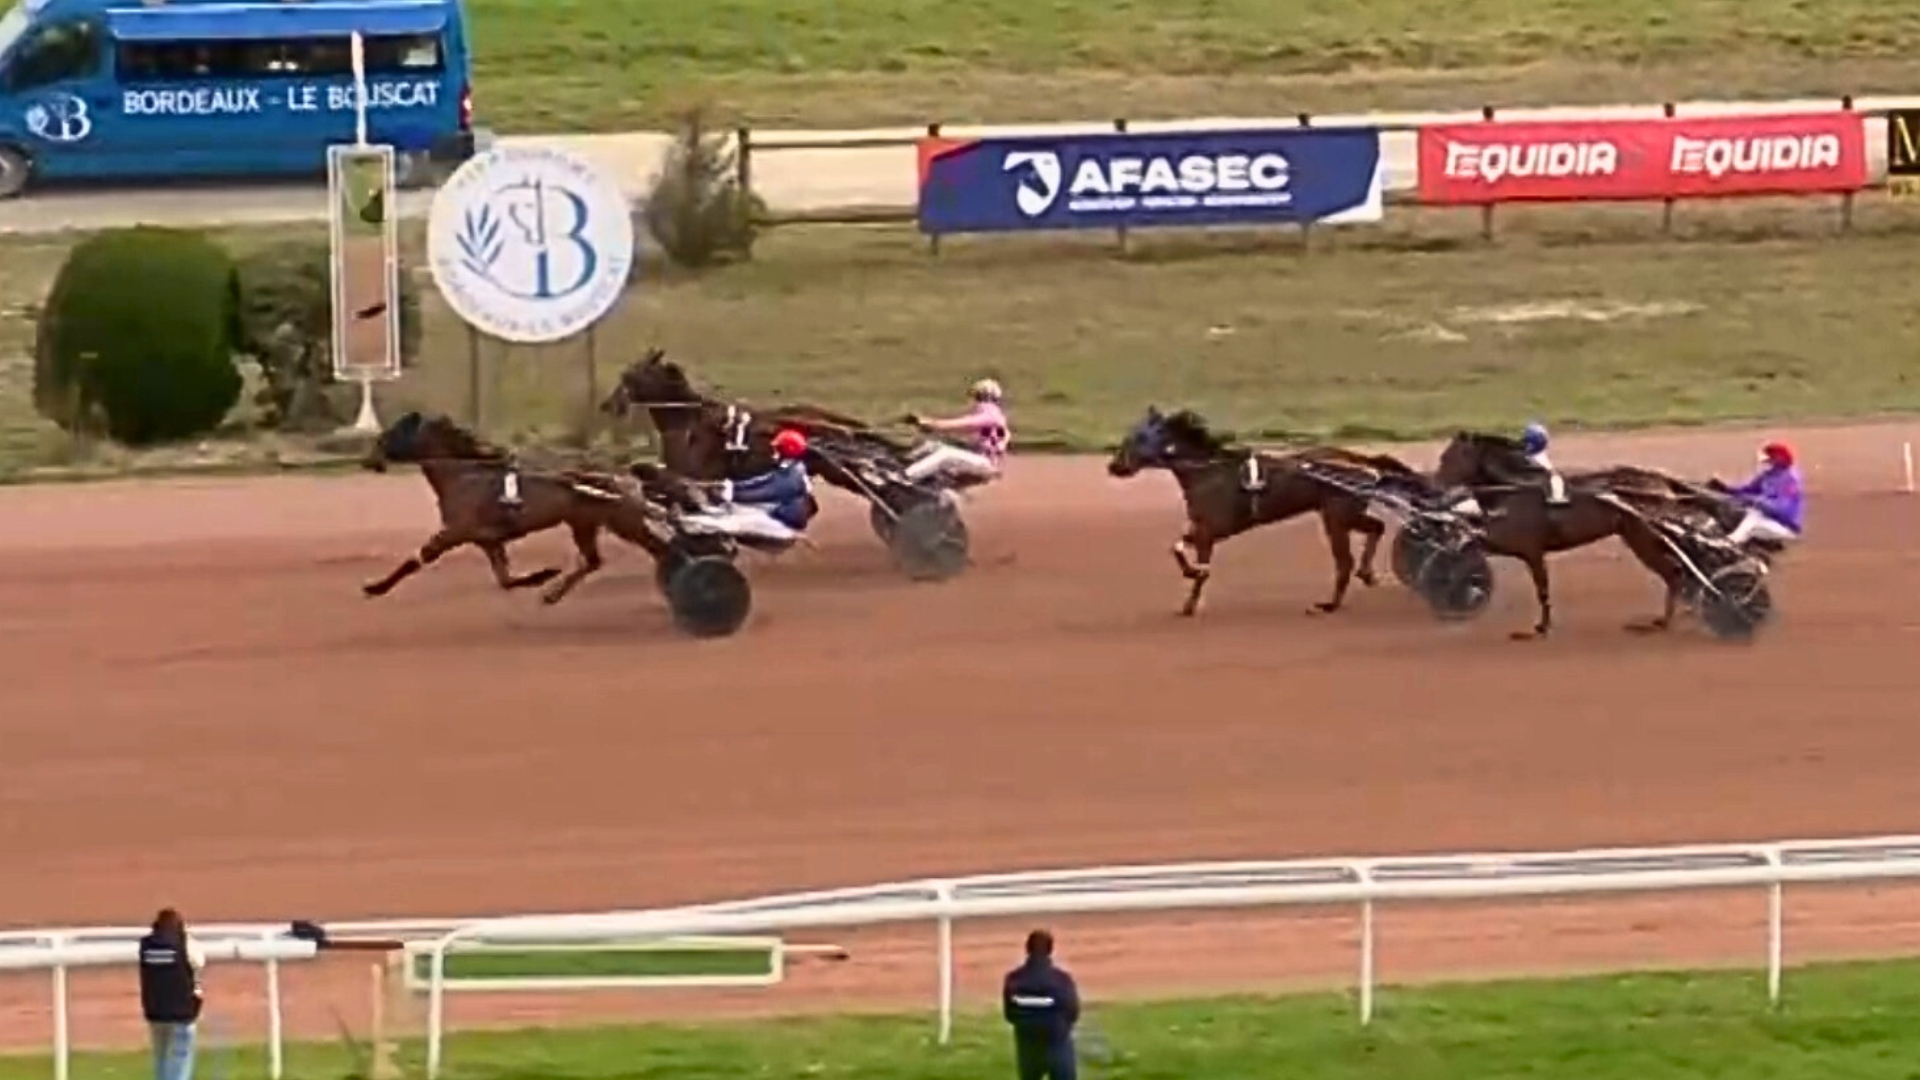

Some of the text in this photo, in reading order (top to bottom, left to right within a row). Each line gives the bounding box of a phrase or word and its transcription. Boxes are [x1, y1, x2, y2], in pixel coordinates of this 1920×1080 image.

[123, 88, 260, 115] BORDEAUX
[287, 85, 318, 111] LE
[1069, 153, 1291, 194] AFASEC
